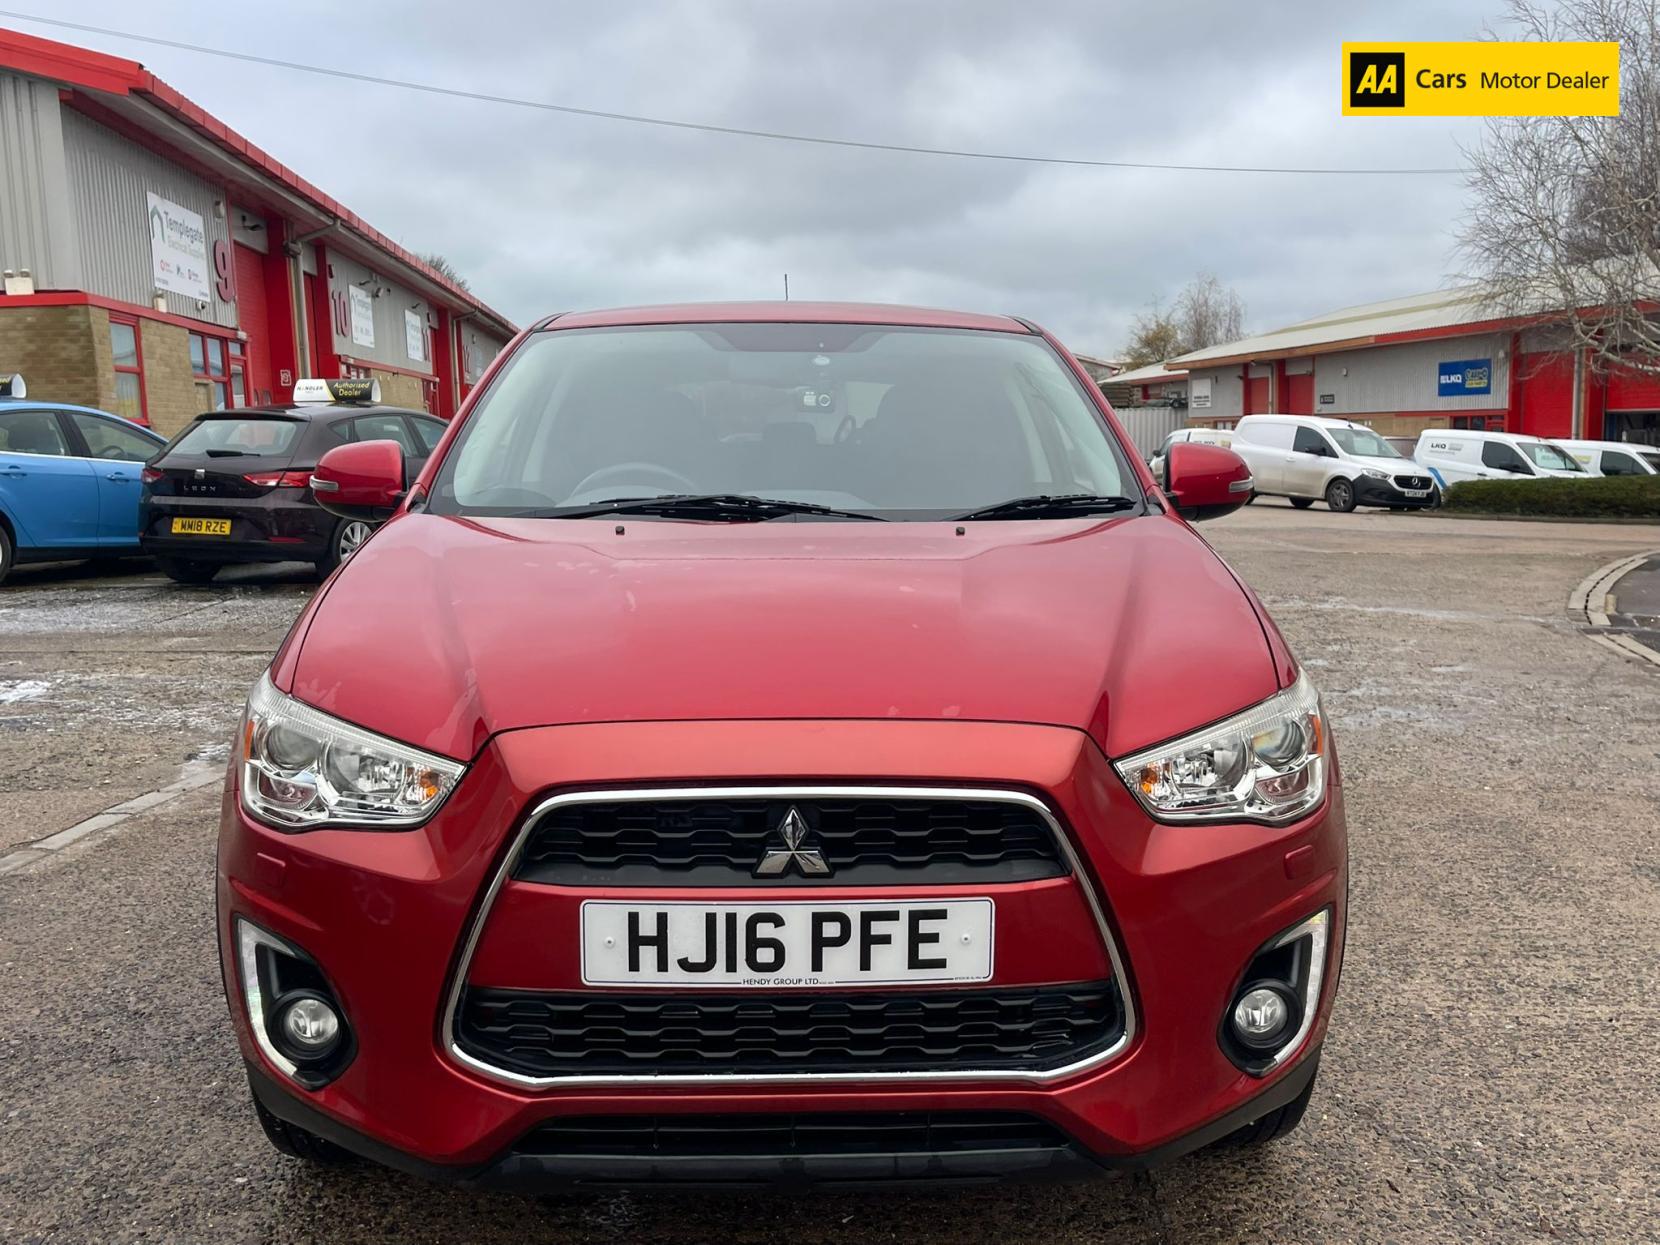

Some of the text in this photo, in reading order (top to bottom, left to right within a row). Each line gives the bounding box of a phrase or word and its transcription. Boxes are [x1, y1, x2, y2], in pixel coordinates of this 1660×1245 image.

[163, 210, 204, 244] Templegate
[213, 240, 237, 304] 9
[331, 289, 351, 338] 10
[338, 389, 362, 397] Dealer
[205, 521, 227, 533] RZE
[627, 909, 948, 973] HJ16 PFE
[742, 977, 819, 986] HENDY GROUP LTD
